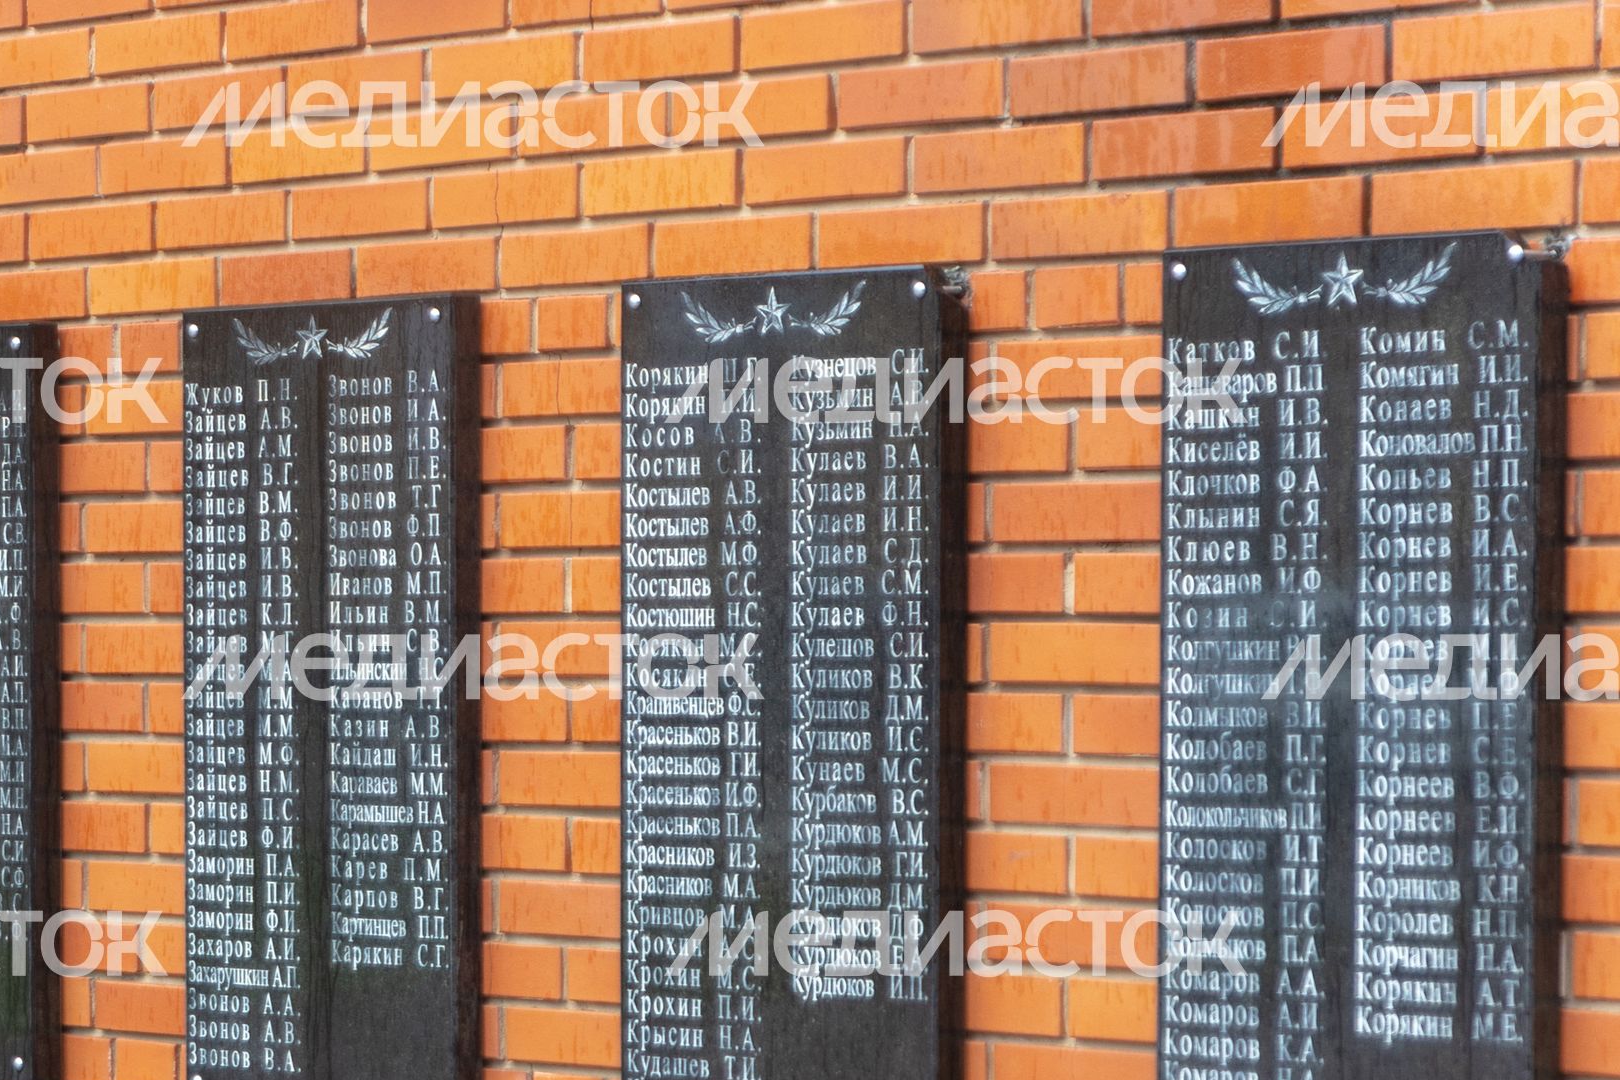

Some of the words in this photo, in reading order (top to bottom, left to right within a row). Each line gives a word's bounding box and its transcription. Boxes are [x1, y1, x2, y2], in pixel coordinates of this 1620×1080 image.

[1168, 337, 1256, 364] Катков
[1275, 331, 1328, 360] С.И.
[1360, 328, 1445, 354] Комин
[1468, 321, 1529, 350] С.М.
[1360, 363, 1459, 389] Комягин
[1479, 357, 1528, 385] И.И.
[186, 384, 243, 410] Жуков
[258, 379, 298, 402] П.Н.
[186, 437, 245, 462] Зайцев
[259, 435, 298, 458] А.М.
[329, 432, 392, 455] Звонов
[408, 428, 446, 450] И.В.
[1167, 434, 1260, 462] Киселёв
[1279, 432, 1328, 460] И.И.
[1359, 431, 1475, 457] Коновалов
[1481, 426, 1528, 455] П.Н.
[792, 448, 866, 479] Кулаев
[884, 443, 929, 469] В.А.
[2, 497, 26, 517] П.А.
[626, 484, 710, 507] Костылев
[725, 480, 761, 506] А.В.
[1167, 503, 1260, 529] Клынин
[1279, 500, 1328, 528] С.Я.
[330, 544, 396, 568] Звонова
[410, 543, 446, 566] О.А.
[330, 572, 392, 596] Иванов
[406, 571, 446, 595] М.П.
[330, 602, 388, 624] Ильин
[404, 600, 446, 624] В.М.
[626, 602, 715, 628] Костюшин
[728, 602, 761, 628] Н.С.
[792, 634, 874, 663] Кулешов
[890, 633, 929, 658] С.И.
[1, 682, 27, 703] А.П.
[627, 722, 720, 751] Красеньков
[727, 722, 761, 747] В.И.
[330, 743, 396, 768] Кайдаш
[411, 744, 448, 768] И.Н.
[792, 756, 864, 786] Кунаев
[882, 758, 928, 785] М.С.
[1166, 764, 1268, 795] Колобаев
[1285, 768, 1326, 795] С.Г.
[792, 785, 876, 821] Курбаков
[892, 789, 929, 816] В.С.
[1356, 803, 1456, 838] Корнеев
[1479, 806, 1523, 834] Е.И.
[188, 850, 255, 881] Заморин
[267, 853, 299, 877] П.А.
[627, 841, 715, 872] Красников
[729, 843, 760, 870] И.З.
[331, 885, 398, 915] Карпов
[414, 888, 448, 911] В.Г.
[1356, 939, 1458, 971] Корчагин
[1476, 944, 1523, 974] Н.А.
[189, 961, 269, 992] Захарушкин
[273, 966, 300, 989] А.П.
[627, 1020, 703, 1051] Крысин
[719, 1026, 761, 1052] Н.А.
[1164, 1027, 1260, 1063] Комаров
[1276, 1035, 1325, 1064] К.А.
